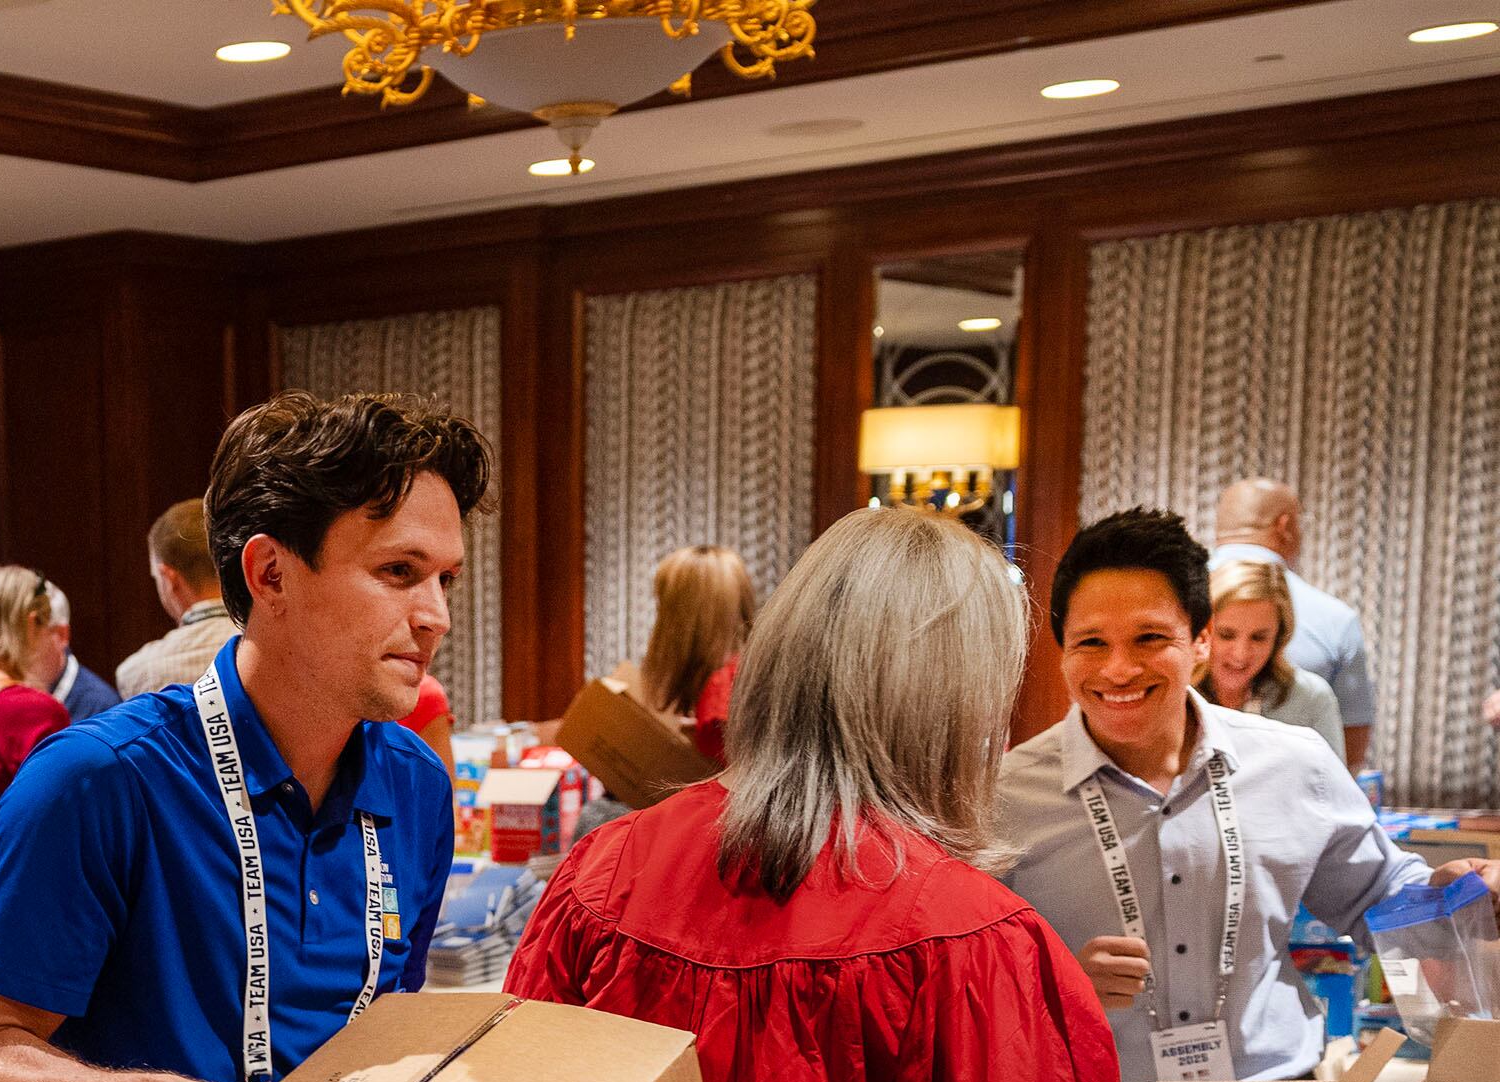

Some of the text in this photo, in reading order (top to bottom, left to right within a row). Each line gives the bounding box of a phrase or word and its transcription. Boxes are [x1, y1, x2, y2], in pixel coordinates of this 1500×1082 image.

[207, 712, 231, 747] USA
[215, 750, 242, 794] TEAM
[1213, 781, 1231, 812] TEAM
[235, 815, 255, 849] USA
[365, 825, 377, 857] USA
[1224, 827, 1239, 853] USA
[1087, 795, 1138, 924] TEAM USA TEAM USA
[1230, 855, 1242, 886] TEAM
[242, 856, 260, 901] TEAM
[369, 881, 382, 923] TEAM
[1228, 903, 1241, 925] USA
[250, 923, 264, 957] USA
[369, 928, 381, 960] USA
[249, 964, 265, 1009] TEAM
[1162, 1040, 1221, 1057] ASSEMBLY
[1179, 1053, 1208, 1066] 2025
